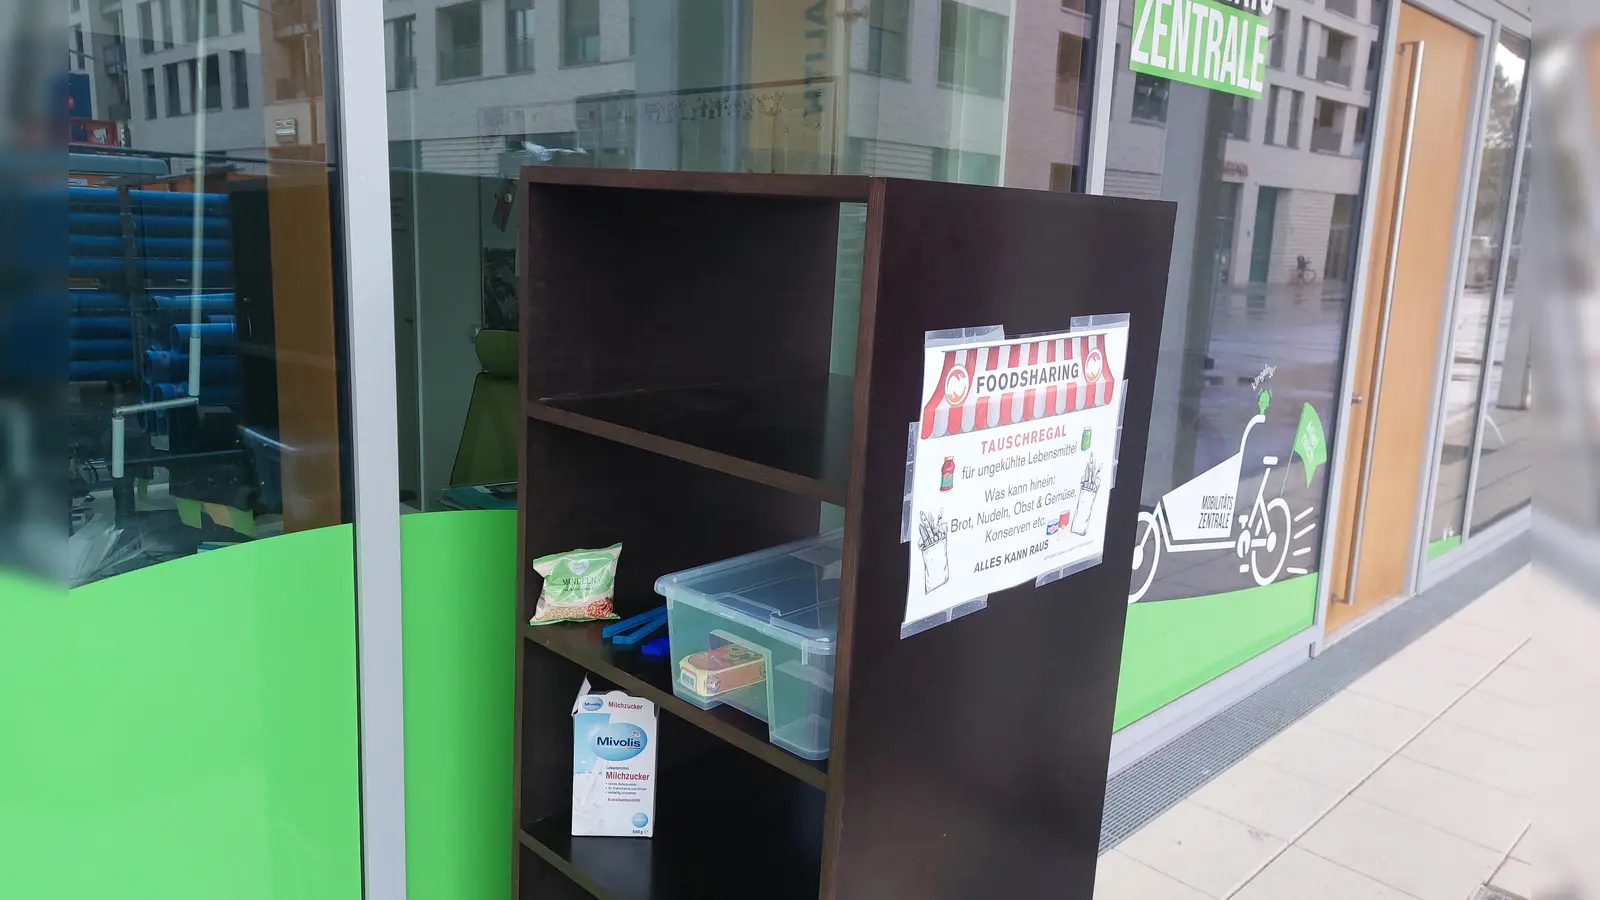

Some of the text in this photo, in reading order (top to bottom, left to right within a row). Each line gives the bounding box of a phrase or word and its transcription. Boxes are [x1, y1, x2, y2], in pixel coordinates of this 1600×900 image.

[1131, 0, 1269, 93] ZENTRALE
[976, 362, 1080, 394] FOODSHARING
[981, 425, 1067, 454] TAUSCHREGAL
[962, 441, 1078, 480] für ungekühlte Lebensmittel
[984, 475, 1056, 502] Was kann hinein:
[1201, 493, 1234, 510] MOBILITÄTS
[950, 488, 1077, 533] Brot, Nudeln, Obst & Gemüse,
[1198, 512, 1231, 529] ZENTRALE
[985, 516, 1047, 544] Konserven etc.
[973, 555, 1002, 573] ALLES
[1004, 548, 1028, 565] KANN
[1029, 539, 1049, 556] RAUS
[607, 701, 643, 710] Milchzucker
[596, 736, 641, 748] Mivolis
[605, 771, 650, 781] Milchzucker
